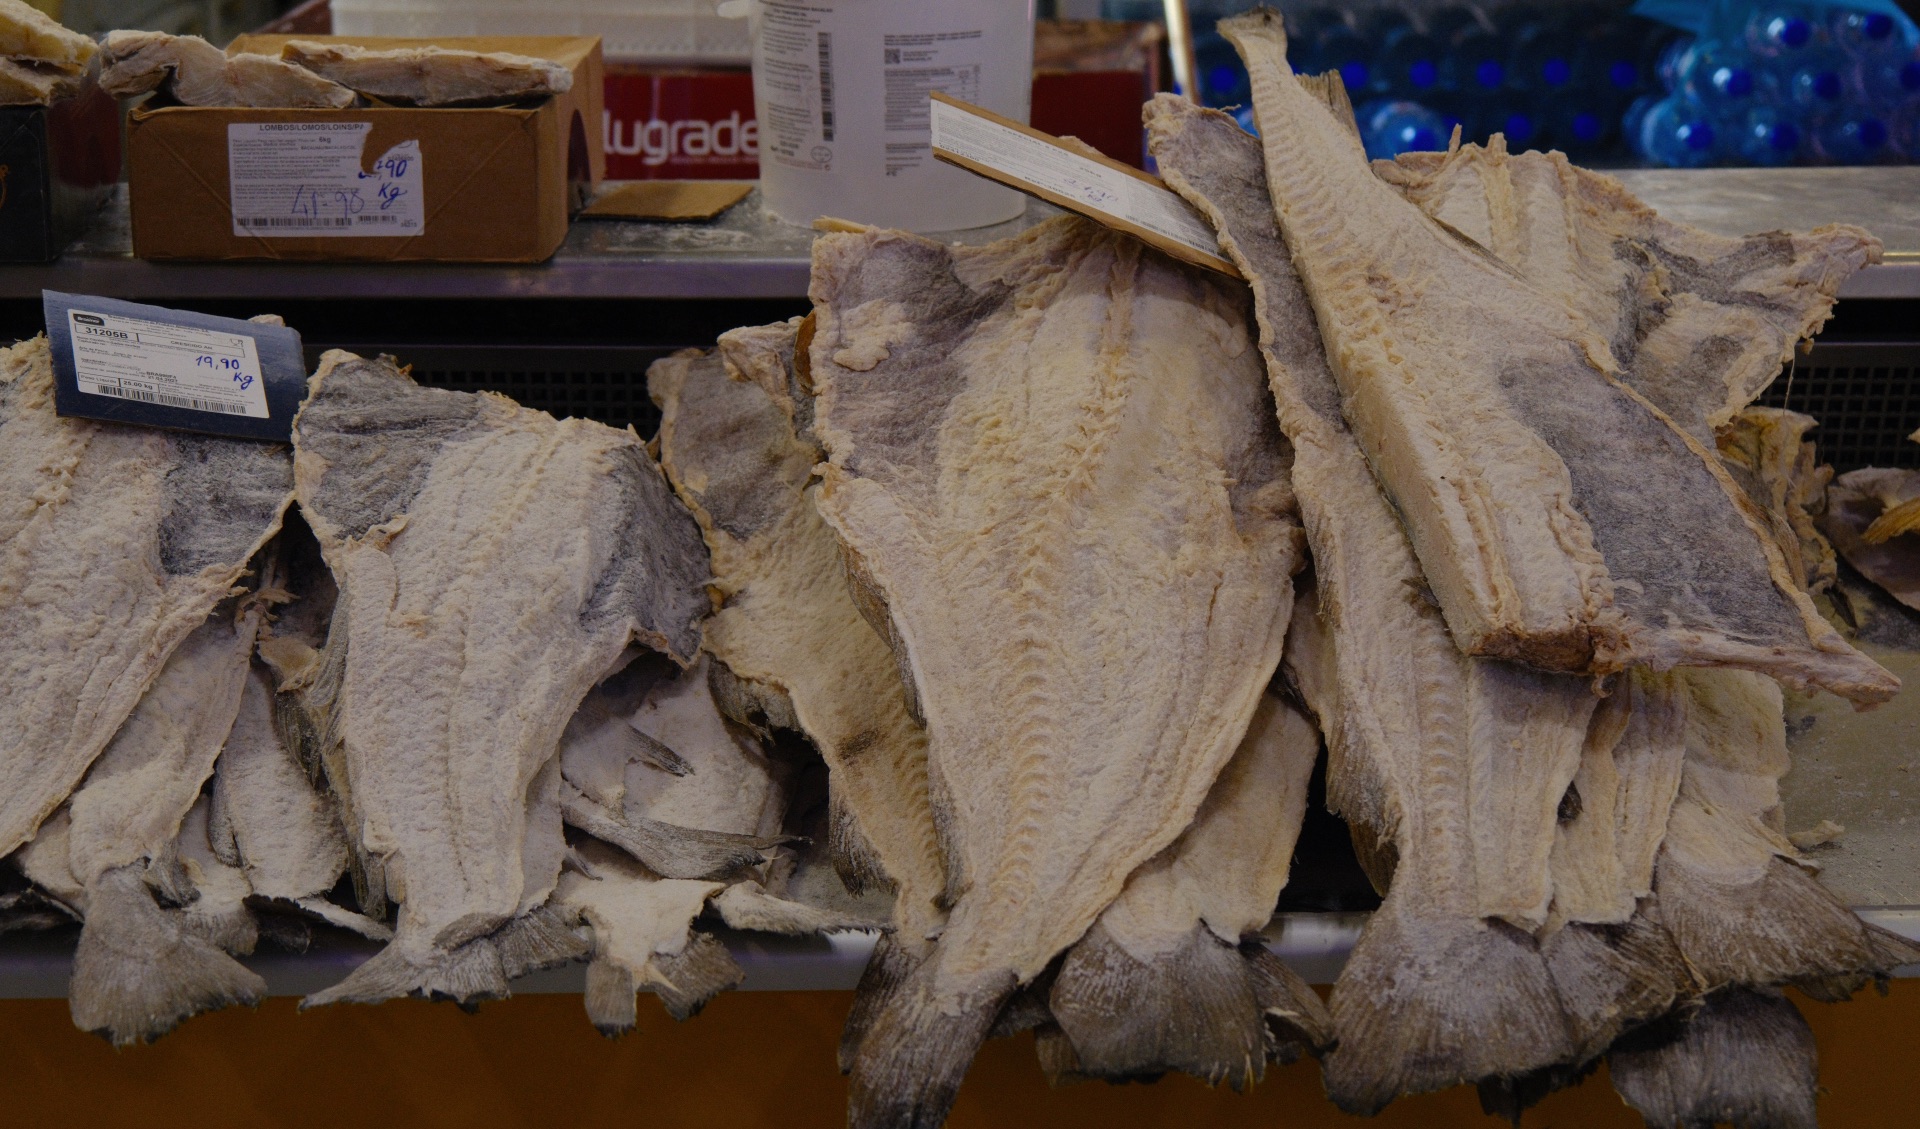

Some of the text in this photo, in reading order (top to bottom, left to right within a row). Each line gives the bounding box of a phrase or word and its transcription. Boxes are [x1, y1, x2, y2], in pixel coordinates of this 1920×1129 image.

[602, 110, 759, 166] lugrade
[378, 182, 408, 210] Kg
[85, 326, 129, 340] 31205B
[195, 355, 240, 370] 19,90
[232, 372, 255, 391] Kg
